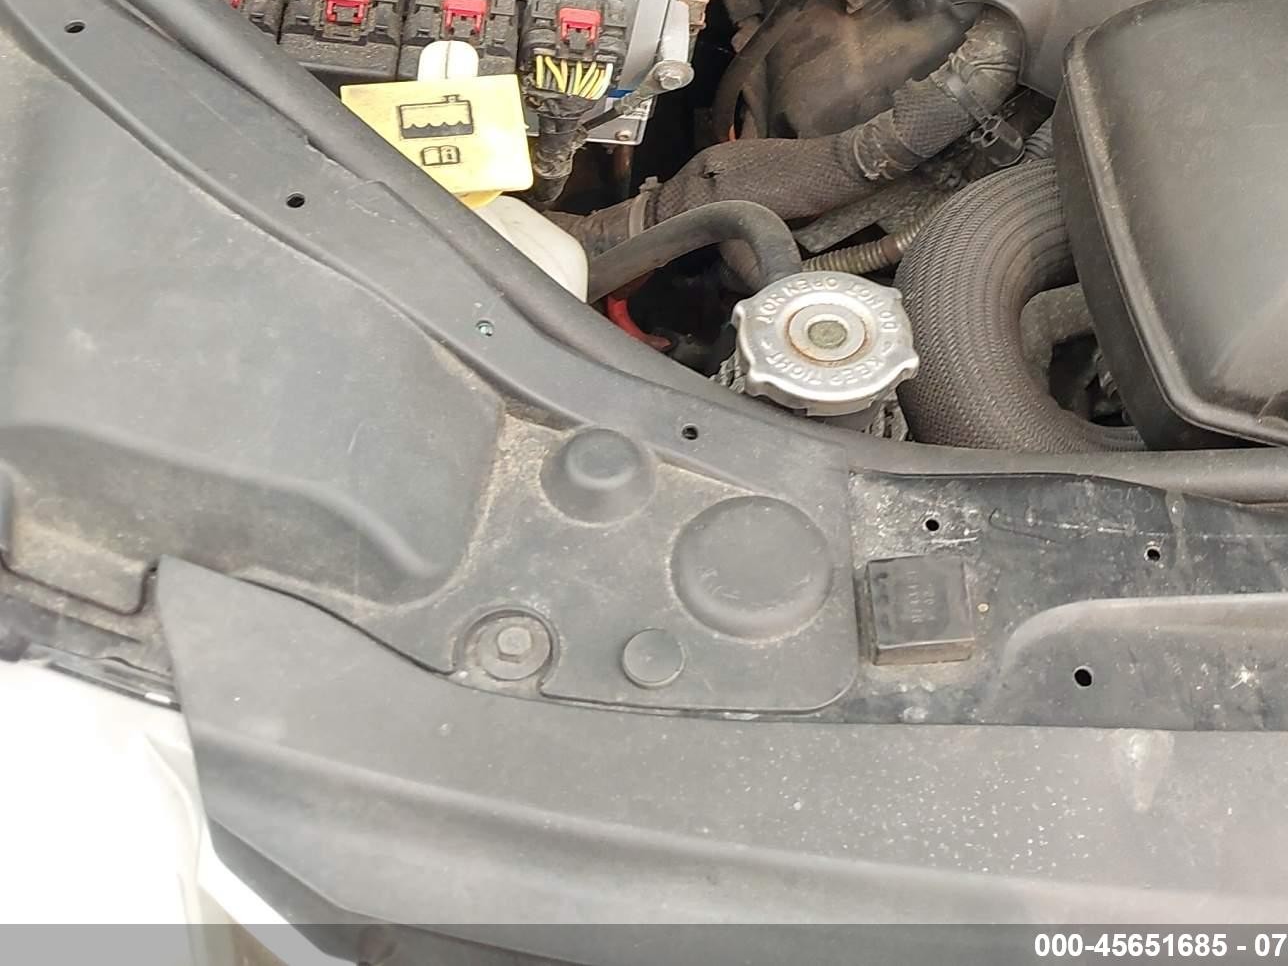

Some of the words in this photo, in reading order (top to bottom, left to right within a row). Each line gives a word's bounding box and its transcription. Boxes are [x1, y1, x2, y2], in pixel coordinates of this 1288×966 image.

[780, 276, 840, 297] OPEN
[844, 282, 885, 310] NOT
[754, 292, 786, 325] HOT
[878, 310, 900, 333] DO
[765, 350, 823, 386] TIGHT
[829, 355, 885, 386] KEEP
